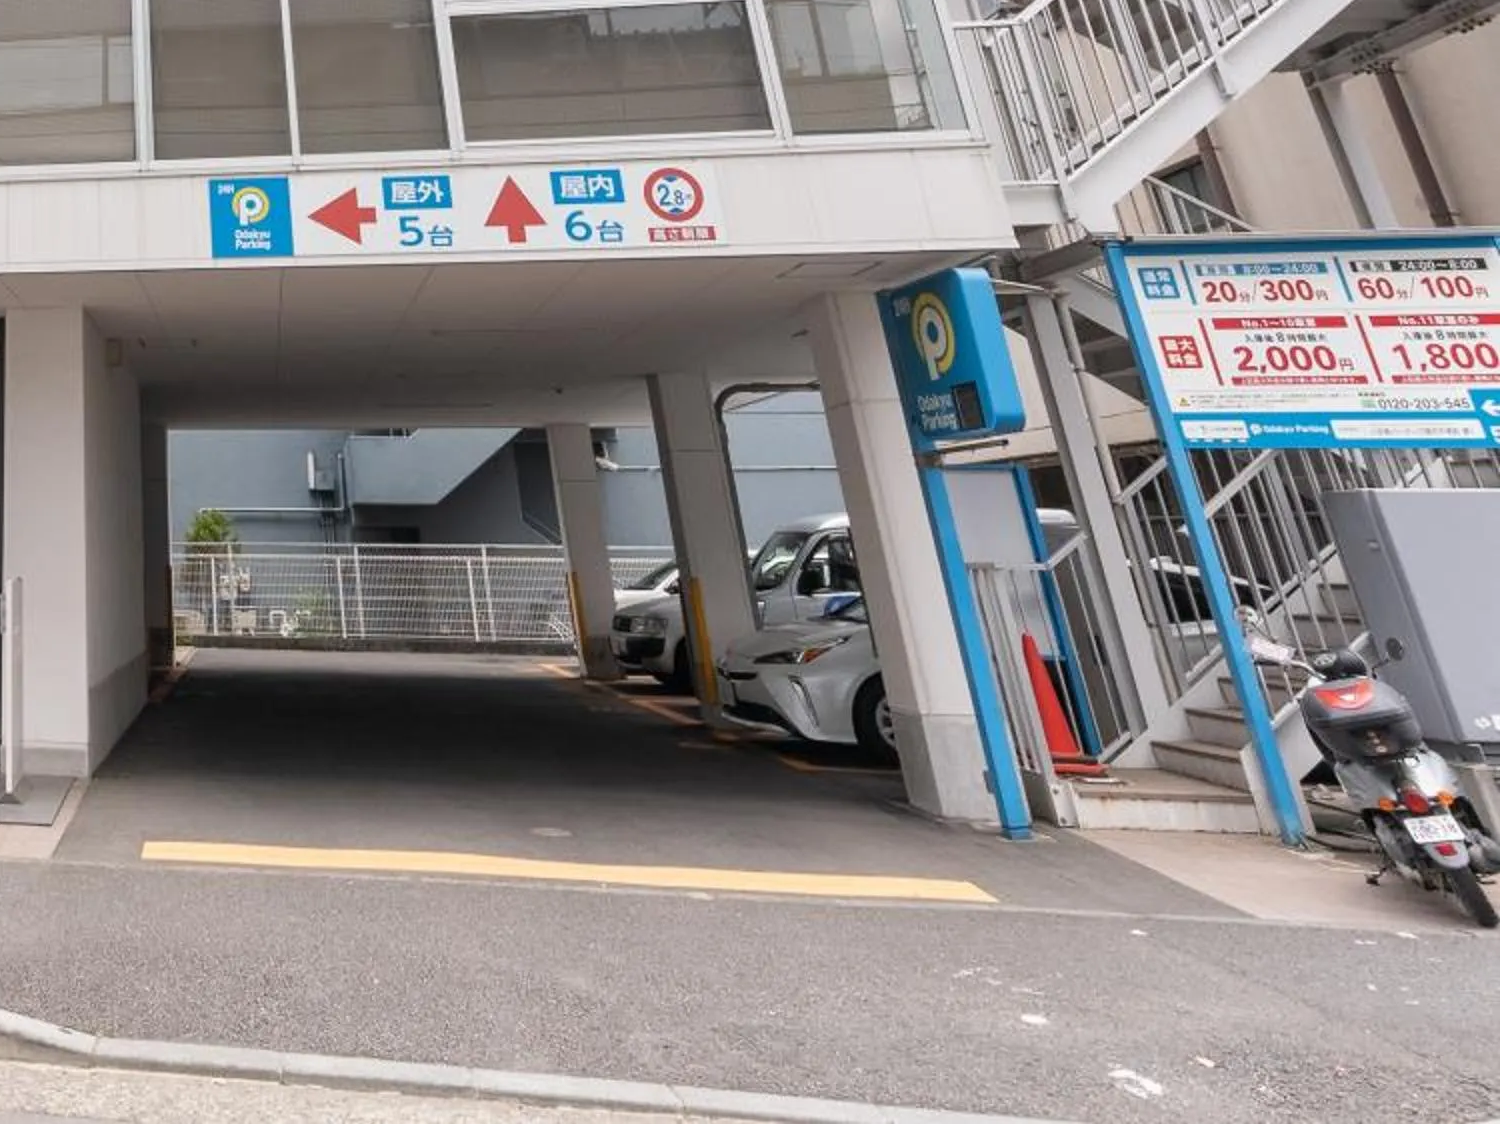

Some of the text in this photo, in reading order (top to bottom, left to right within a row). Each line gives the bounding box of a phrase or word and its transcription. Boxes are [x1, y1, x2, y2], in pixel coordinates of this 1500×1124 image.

[391, 179, 445, 203] 屋外
[560, 174, 616, 199] 屋内
[399, 215, 453, 247] 5台
[565, 209, 624, 243] 6台
